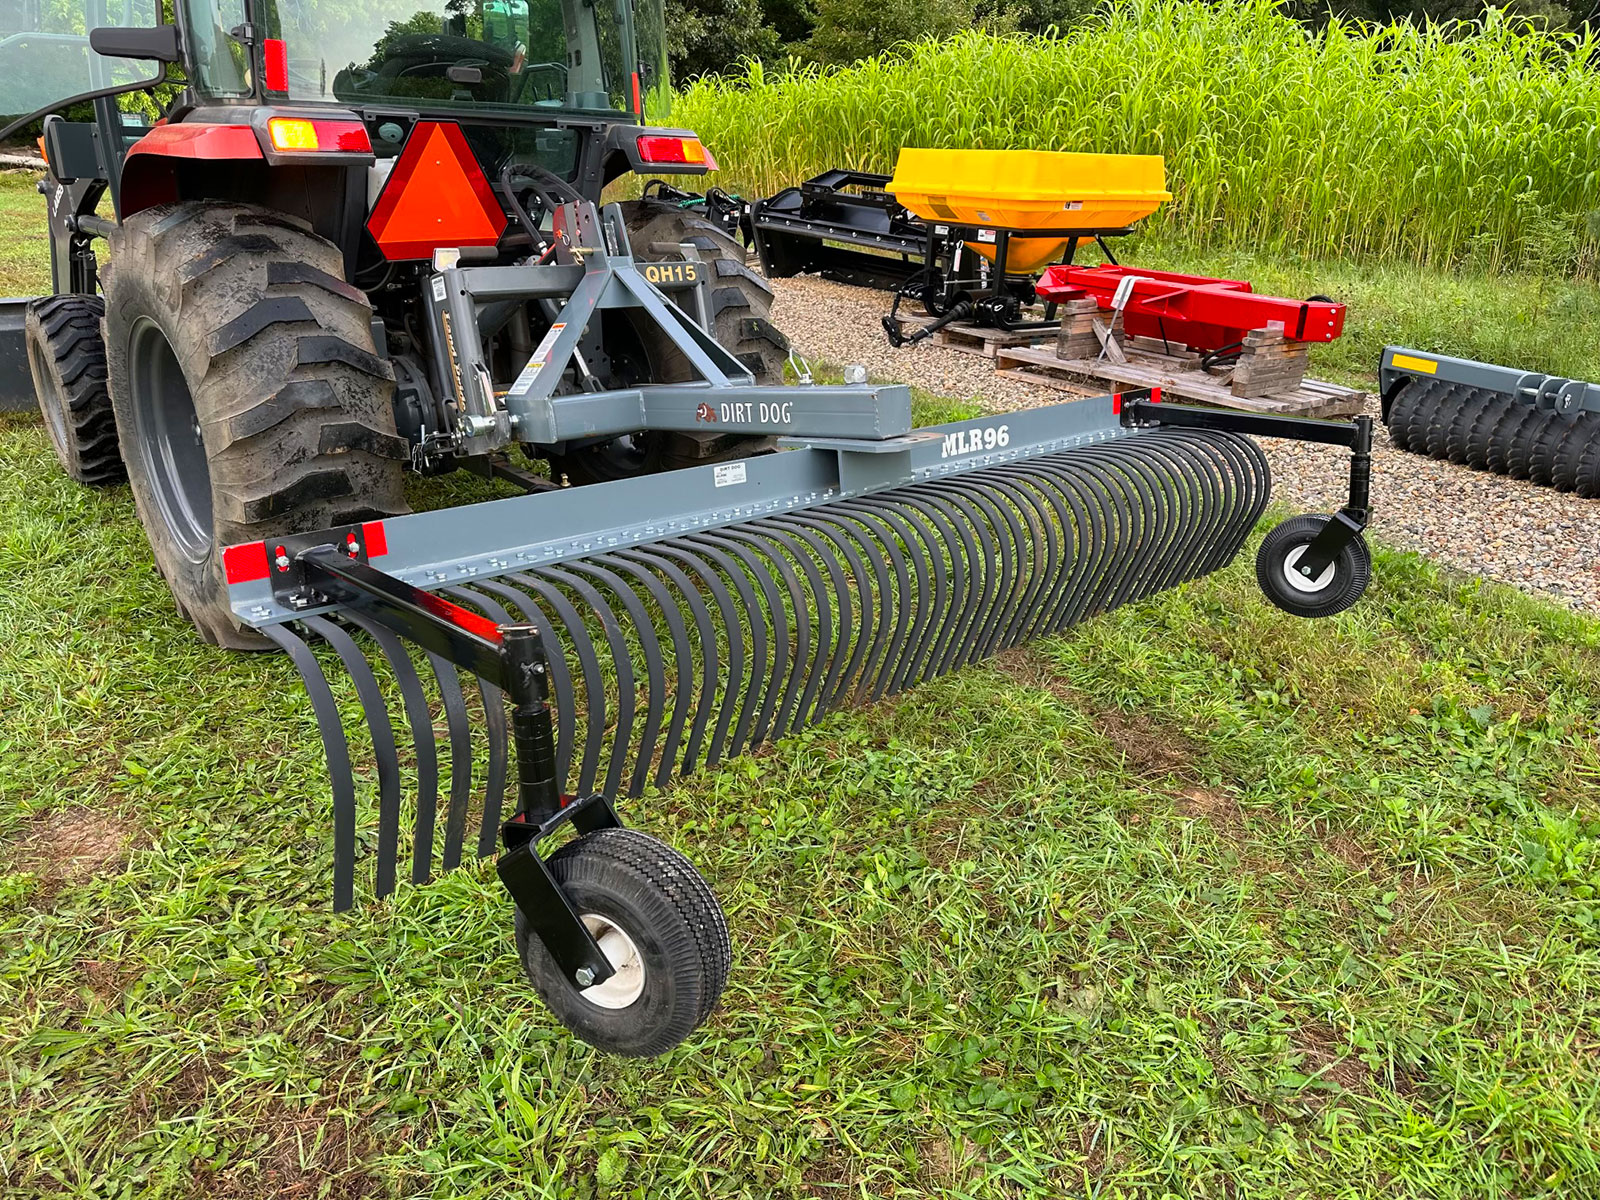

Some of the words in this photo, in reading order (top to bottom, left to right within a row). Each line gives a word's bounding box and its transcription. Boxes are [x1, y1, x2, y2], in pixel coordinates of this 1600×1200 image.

[645, 265, 697, 283] QH15
[720, 402, 753, 423] DIRT
[759, 402, 792, 424] DOG
[941, 424, 1010, 459] MLR96
